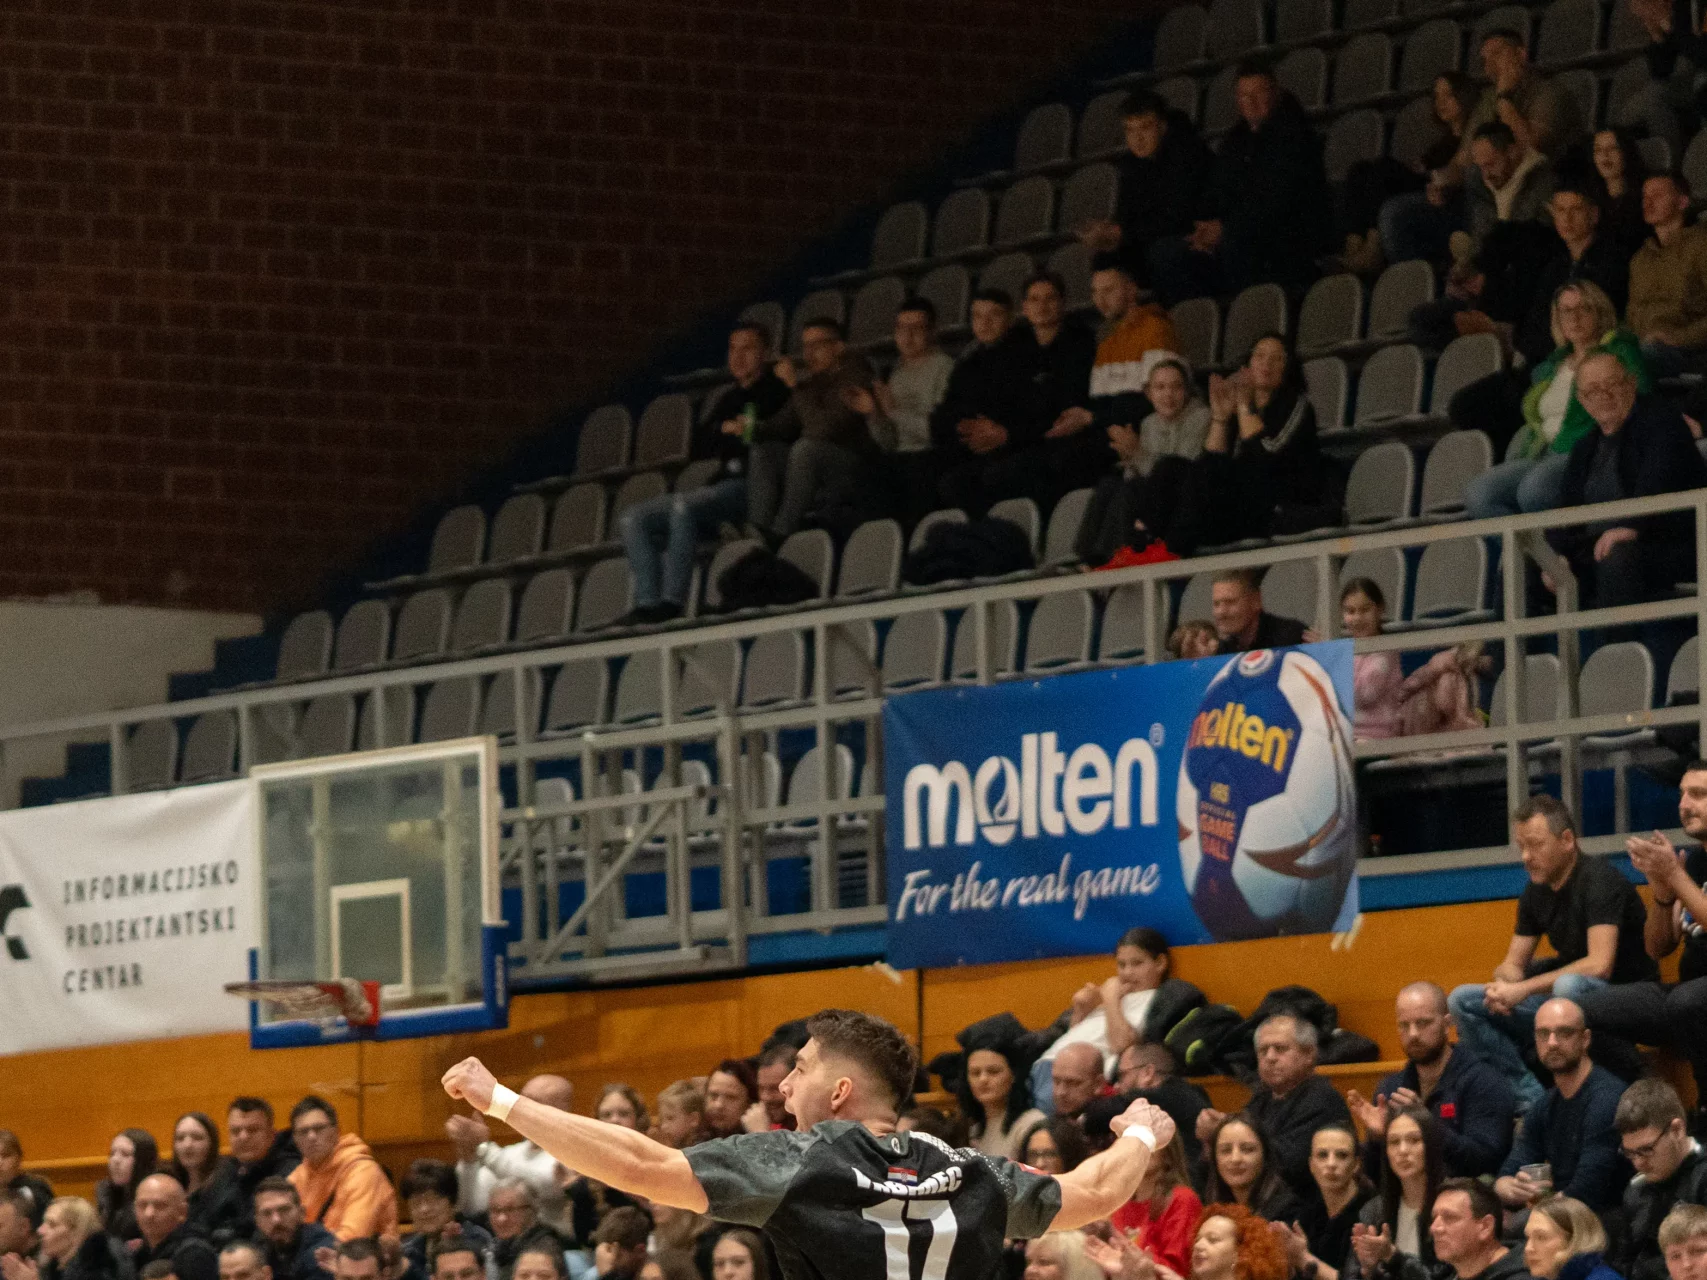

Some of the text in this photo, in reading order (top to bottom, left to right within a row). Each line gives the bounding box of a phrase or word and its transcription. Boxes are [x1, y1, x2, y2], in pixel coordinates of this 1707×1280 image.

[1187, 701, 1290, 773] molten
[903, 731, 1160, 851] molten
[63, 859, 240, 905] INFORMACIJSKO
[896, 852, 1161, 922] For the real game
[65, 906, 236, 948] PROJEKTANTSKI
[63, 962, 143, 994] CENTAR
